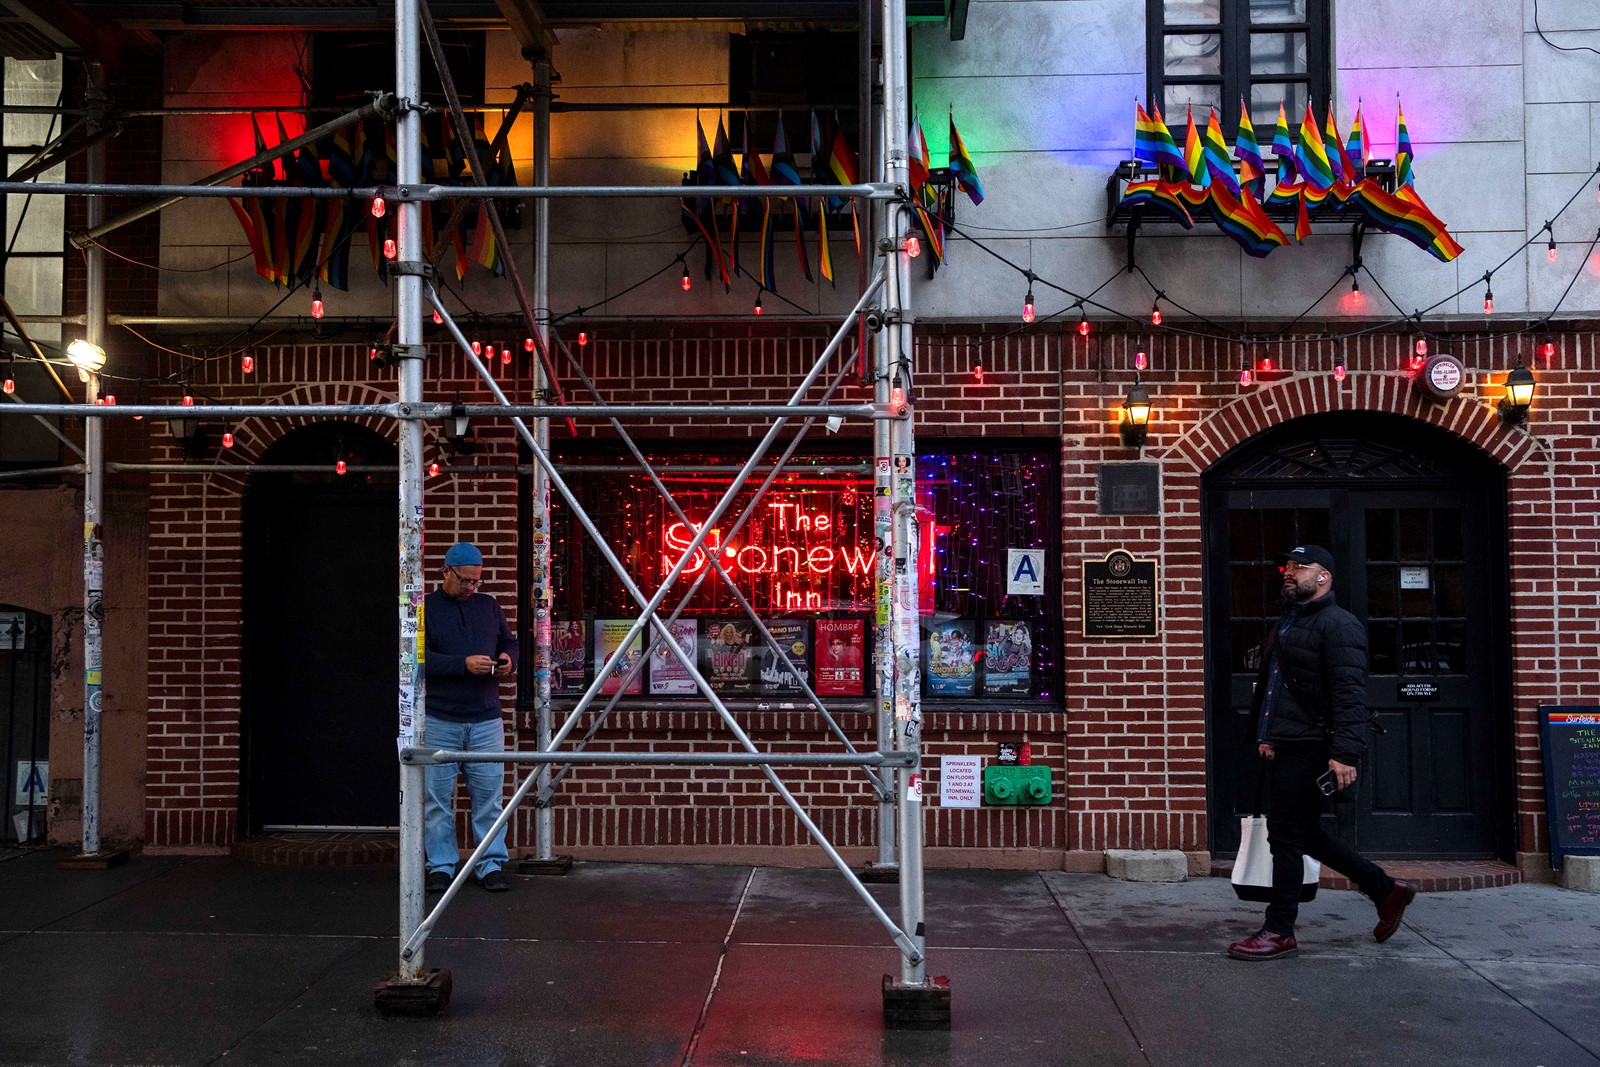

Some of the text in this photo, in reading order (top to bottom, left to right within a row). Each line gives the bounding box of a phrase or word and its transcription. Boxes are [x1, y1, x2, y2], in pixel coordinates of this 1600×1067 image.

[768, 503, 830, 531] The
[1013, 555, 1038, 582] A
[776, 582, 821, 609] Inn
[714, 653, 744, 667] BINGO
[1566, 714, 1596, 723] Surfside
[22, 766, 46, 792] A
